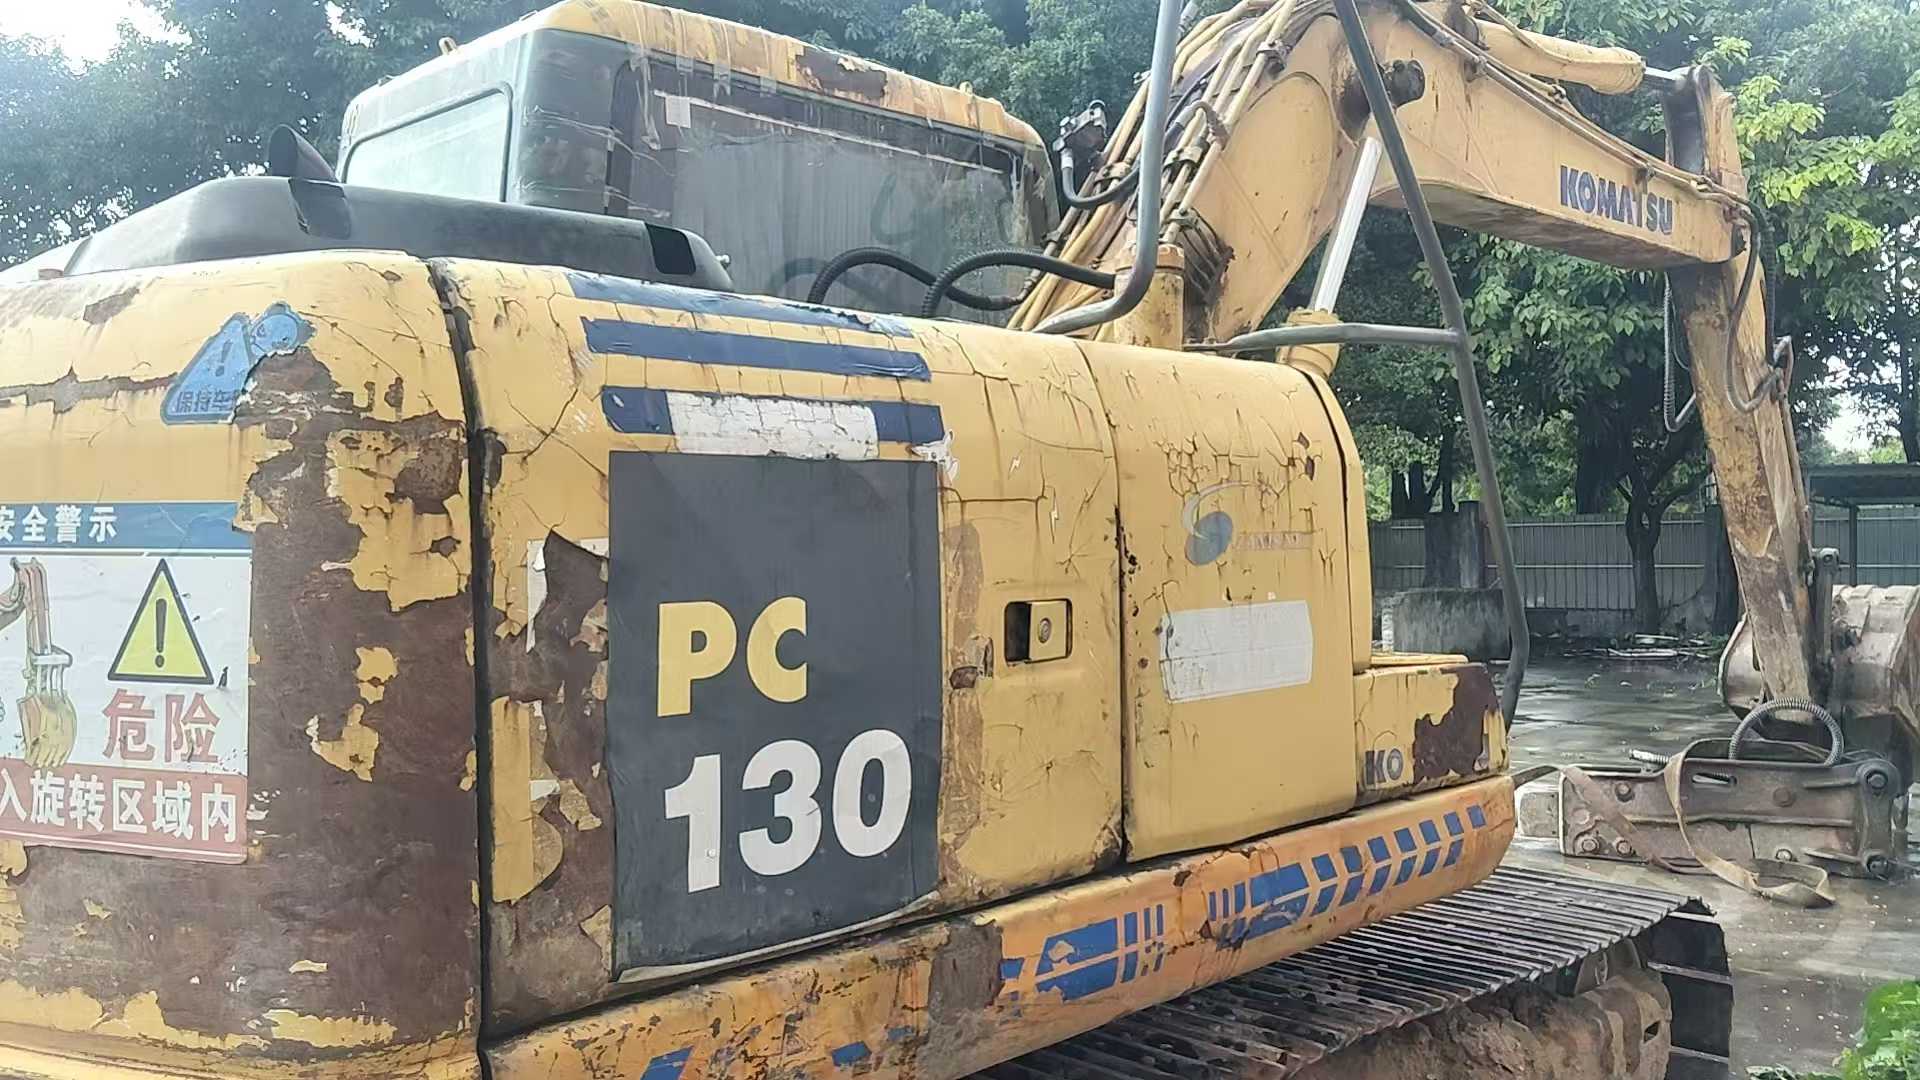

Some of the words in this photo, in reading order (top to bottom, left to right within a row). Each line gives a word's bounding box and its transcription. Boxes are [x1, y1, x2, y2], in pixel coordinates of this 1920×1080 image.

[1560, 165, 1673, 235] KOMATSU
[657, 596, 808, 717] PC
[102, 688, 221, 764] 危险
[664, 729, 912, 893] 130
